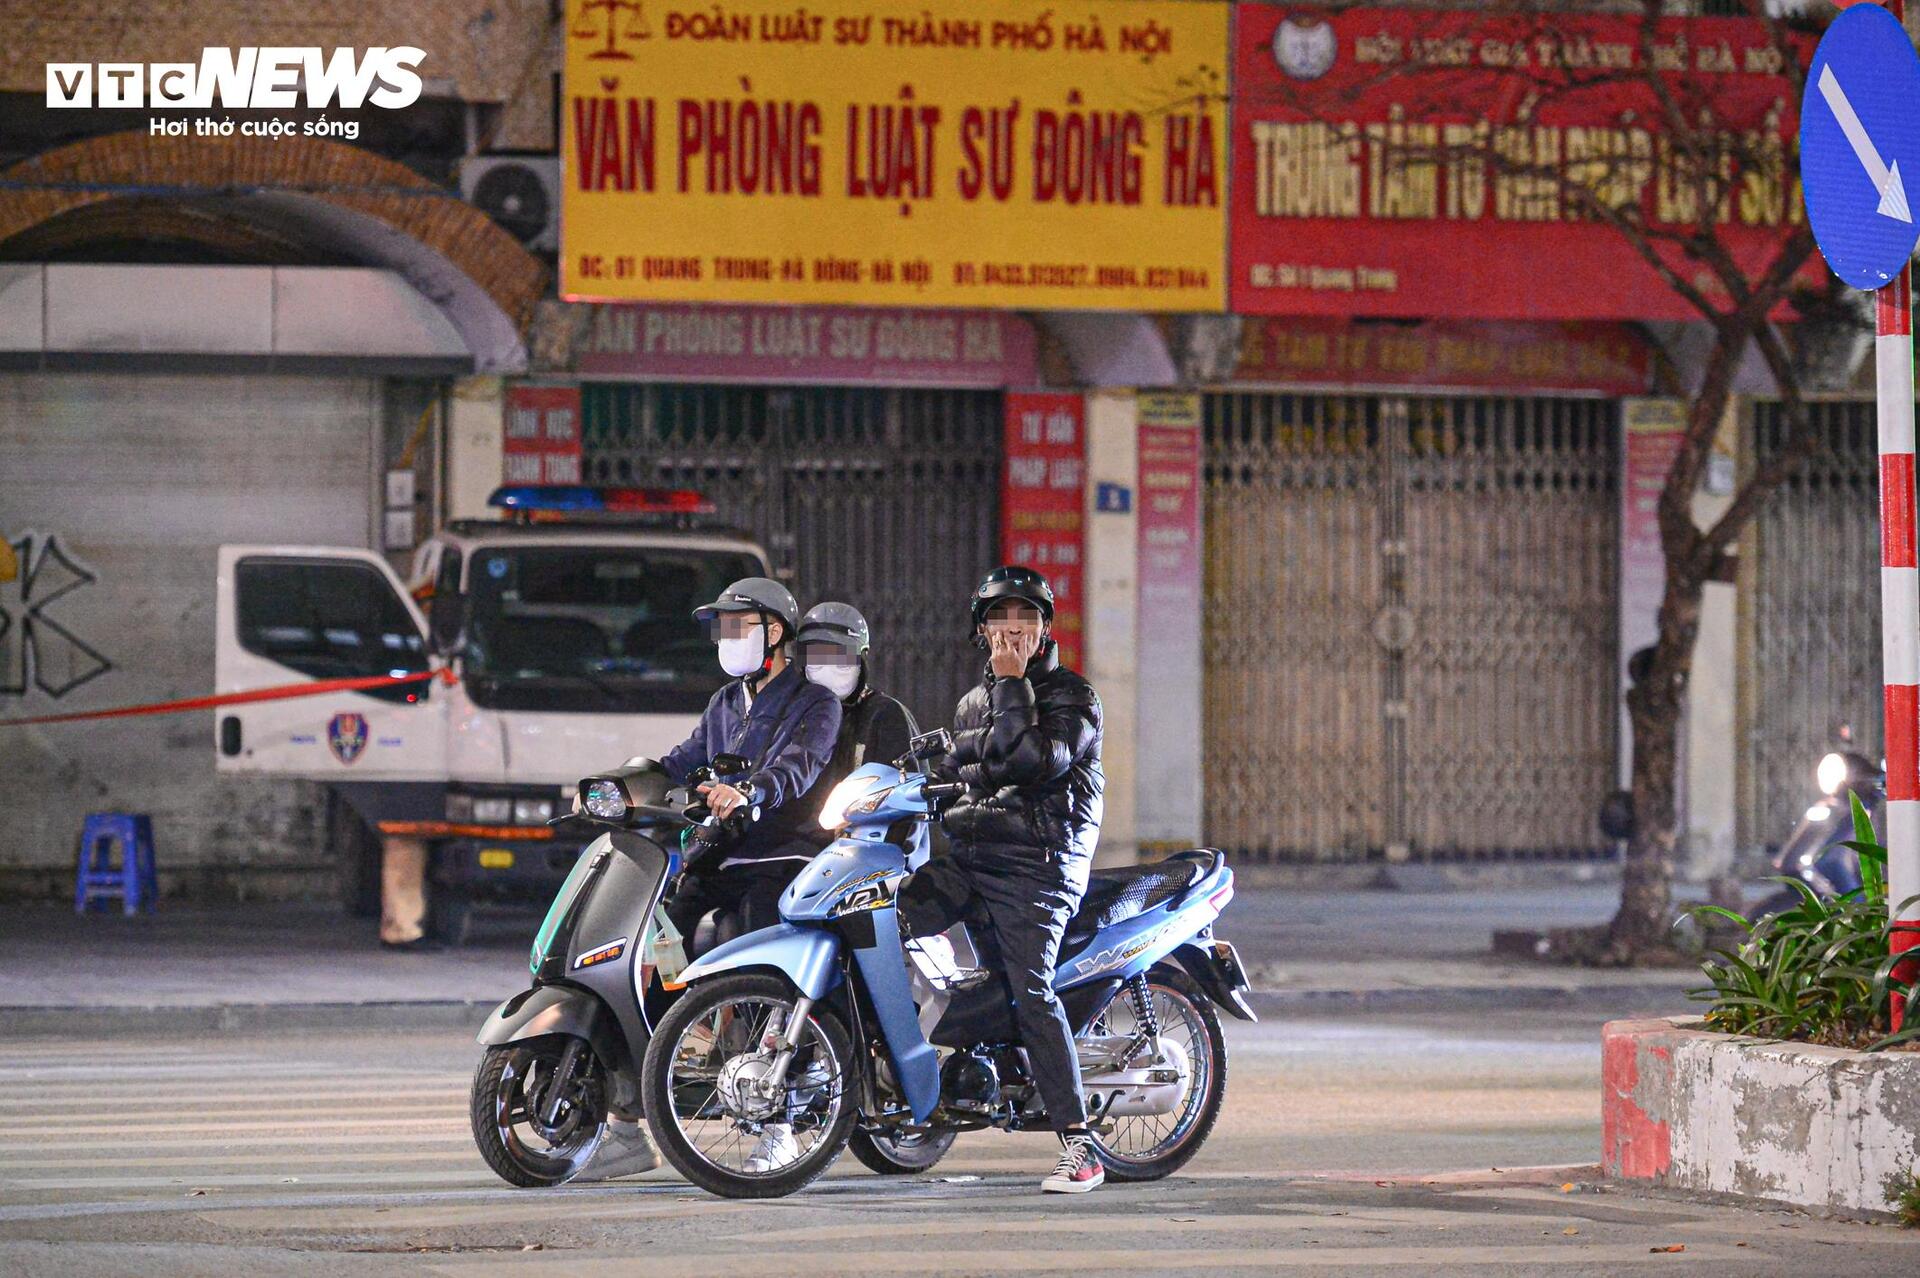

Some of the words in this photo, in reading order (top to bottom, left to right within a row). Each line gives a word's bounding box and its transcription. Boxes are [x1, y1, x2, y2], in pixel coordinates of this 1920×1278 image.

[665, 4, 751, 42] ĐOÀN
[882, 10, 982, 47] THÀNH
[991, 10, 1055, 51] PHỐ
[1063, 14, 1106, 51] HÀ
[1119, 18, 1171, 61] NỘI
[574, 76, 656, 193] VĂN
[677, 74, 823, 196] PHÒNG
[847, 82, 940, 217] LUẬT
[957, 97, 1021, 202] SƯ
[1032, 88, 1147, 207] ĐÔNG
[1252, 119, 1361, 219] TRUNG
